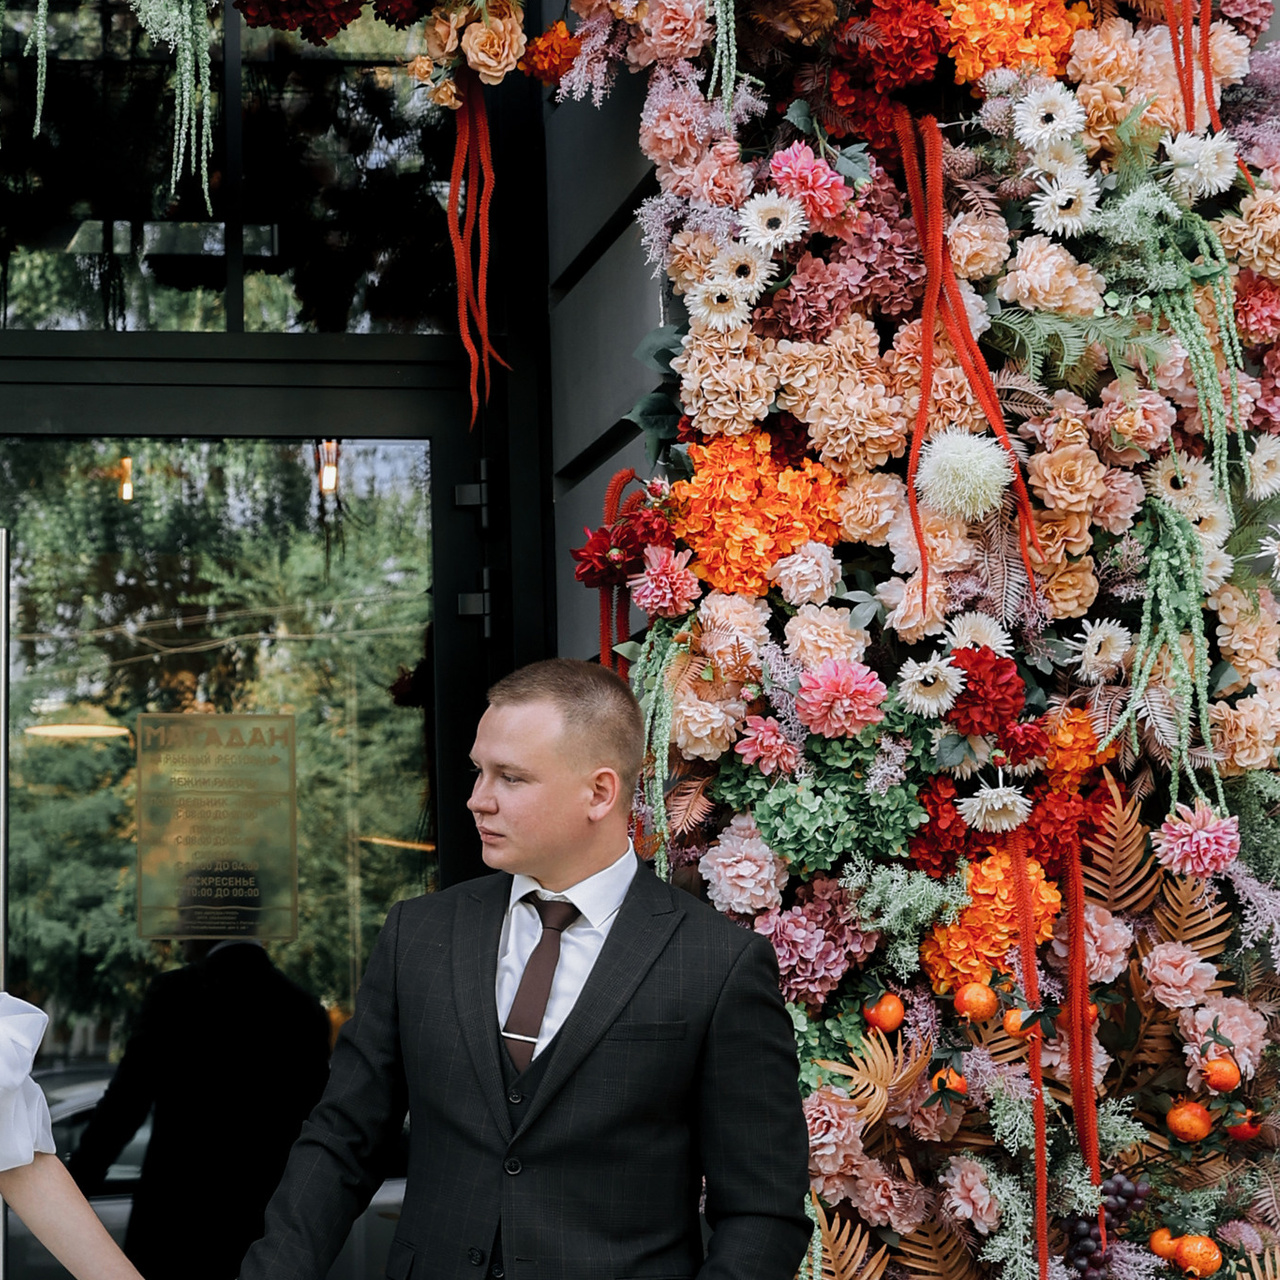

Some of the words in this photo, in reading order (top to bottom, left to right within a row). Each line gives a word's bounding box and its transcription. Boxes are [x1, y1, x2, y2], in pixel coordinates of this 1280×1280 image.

[143, 725, 289, 747] МАГАДАН
[165, 752, 211, 765] РЫБНЫЙ
[170, 777, 211, 787] РЕЖИМ
[214, 861, 230, 872] ДО
[214, 887, 230, 898] ДО
[232, 887, 260, 897] 00:00
